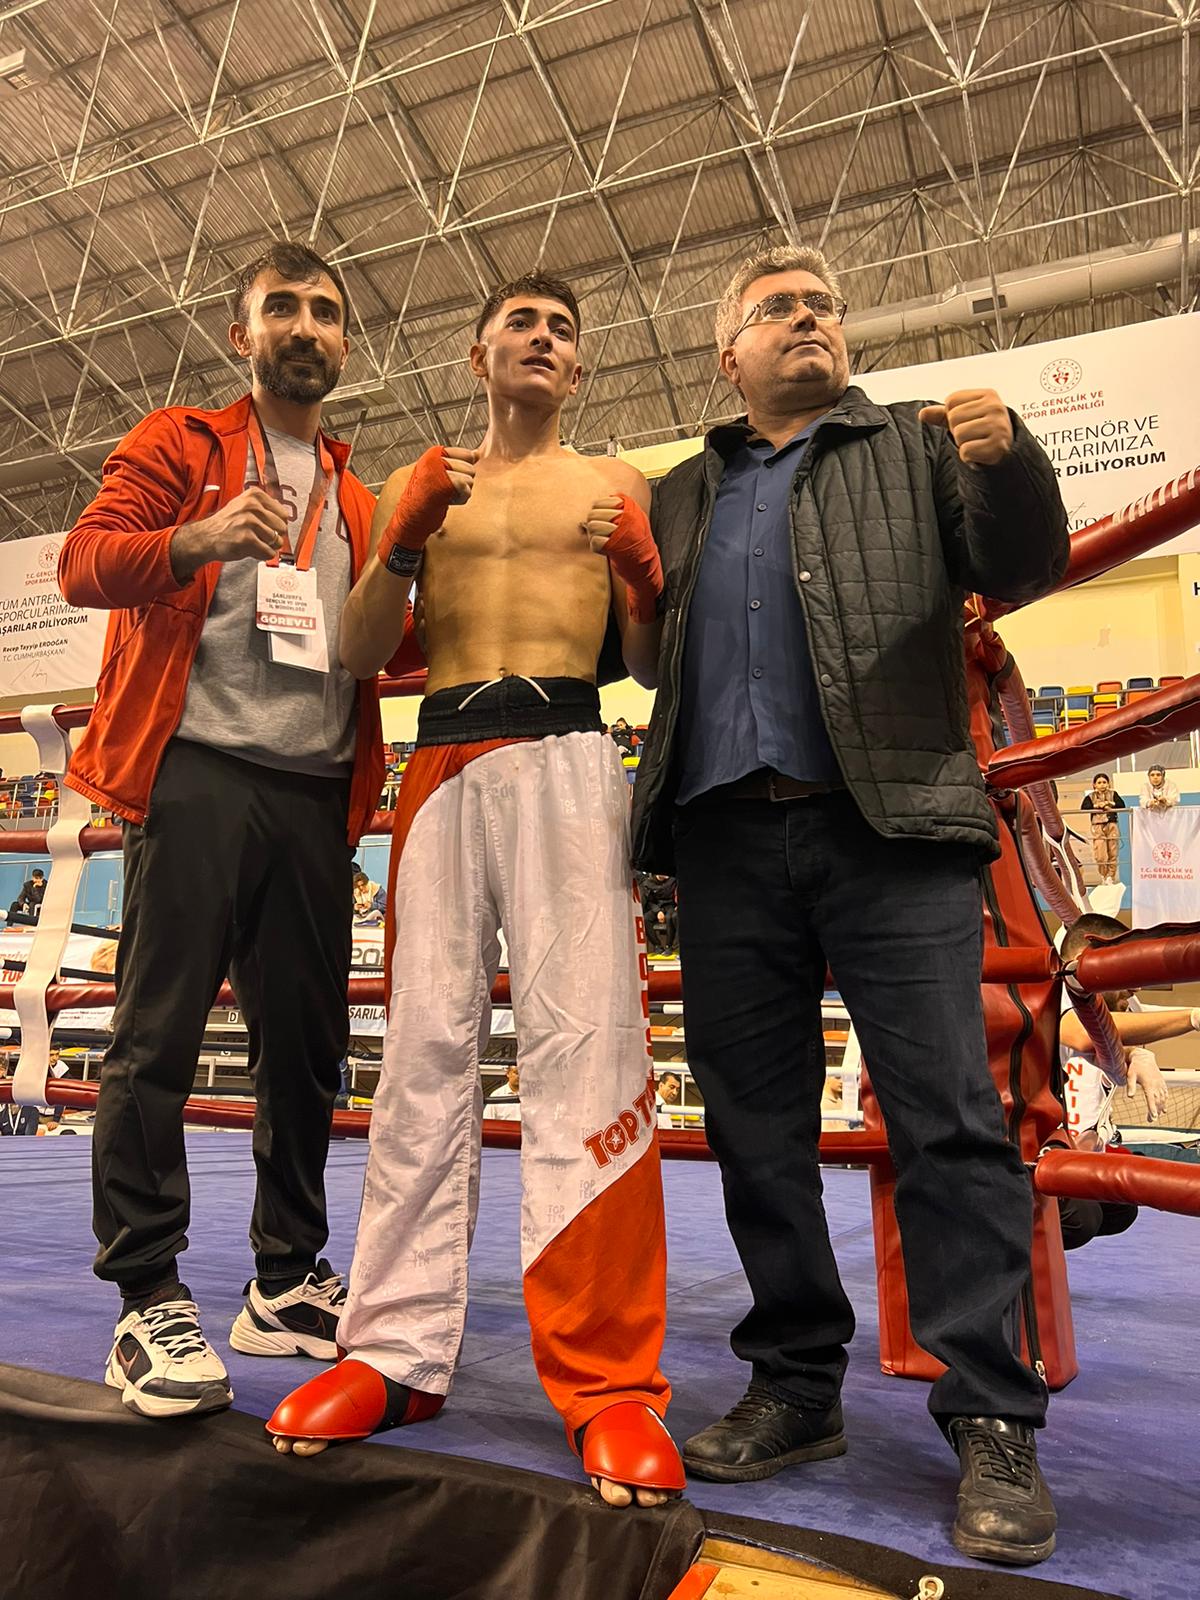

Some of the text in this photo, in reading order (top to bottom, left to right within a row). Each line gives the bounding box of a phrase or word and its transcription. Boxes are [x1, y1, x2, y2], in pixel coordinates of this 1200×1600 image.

[1021, 390, 1104, 411] T.C. GENÇLİK VE
[1022, 400, 1105, 420] SPOR BAKANLIĞI
[1035, 415, 1160, 447] NTRENÖR VE
[1066, 451, 1166, 476] DİLİYORUM
[39, 615, 88, 629] DİLİYORUM
[39, 639, 68, 648] ERDOĞAN
[583, 1109, 640, 1169] TOP
